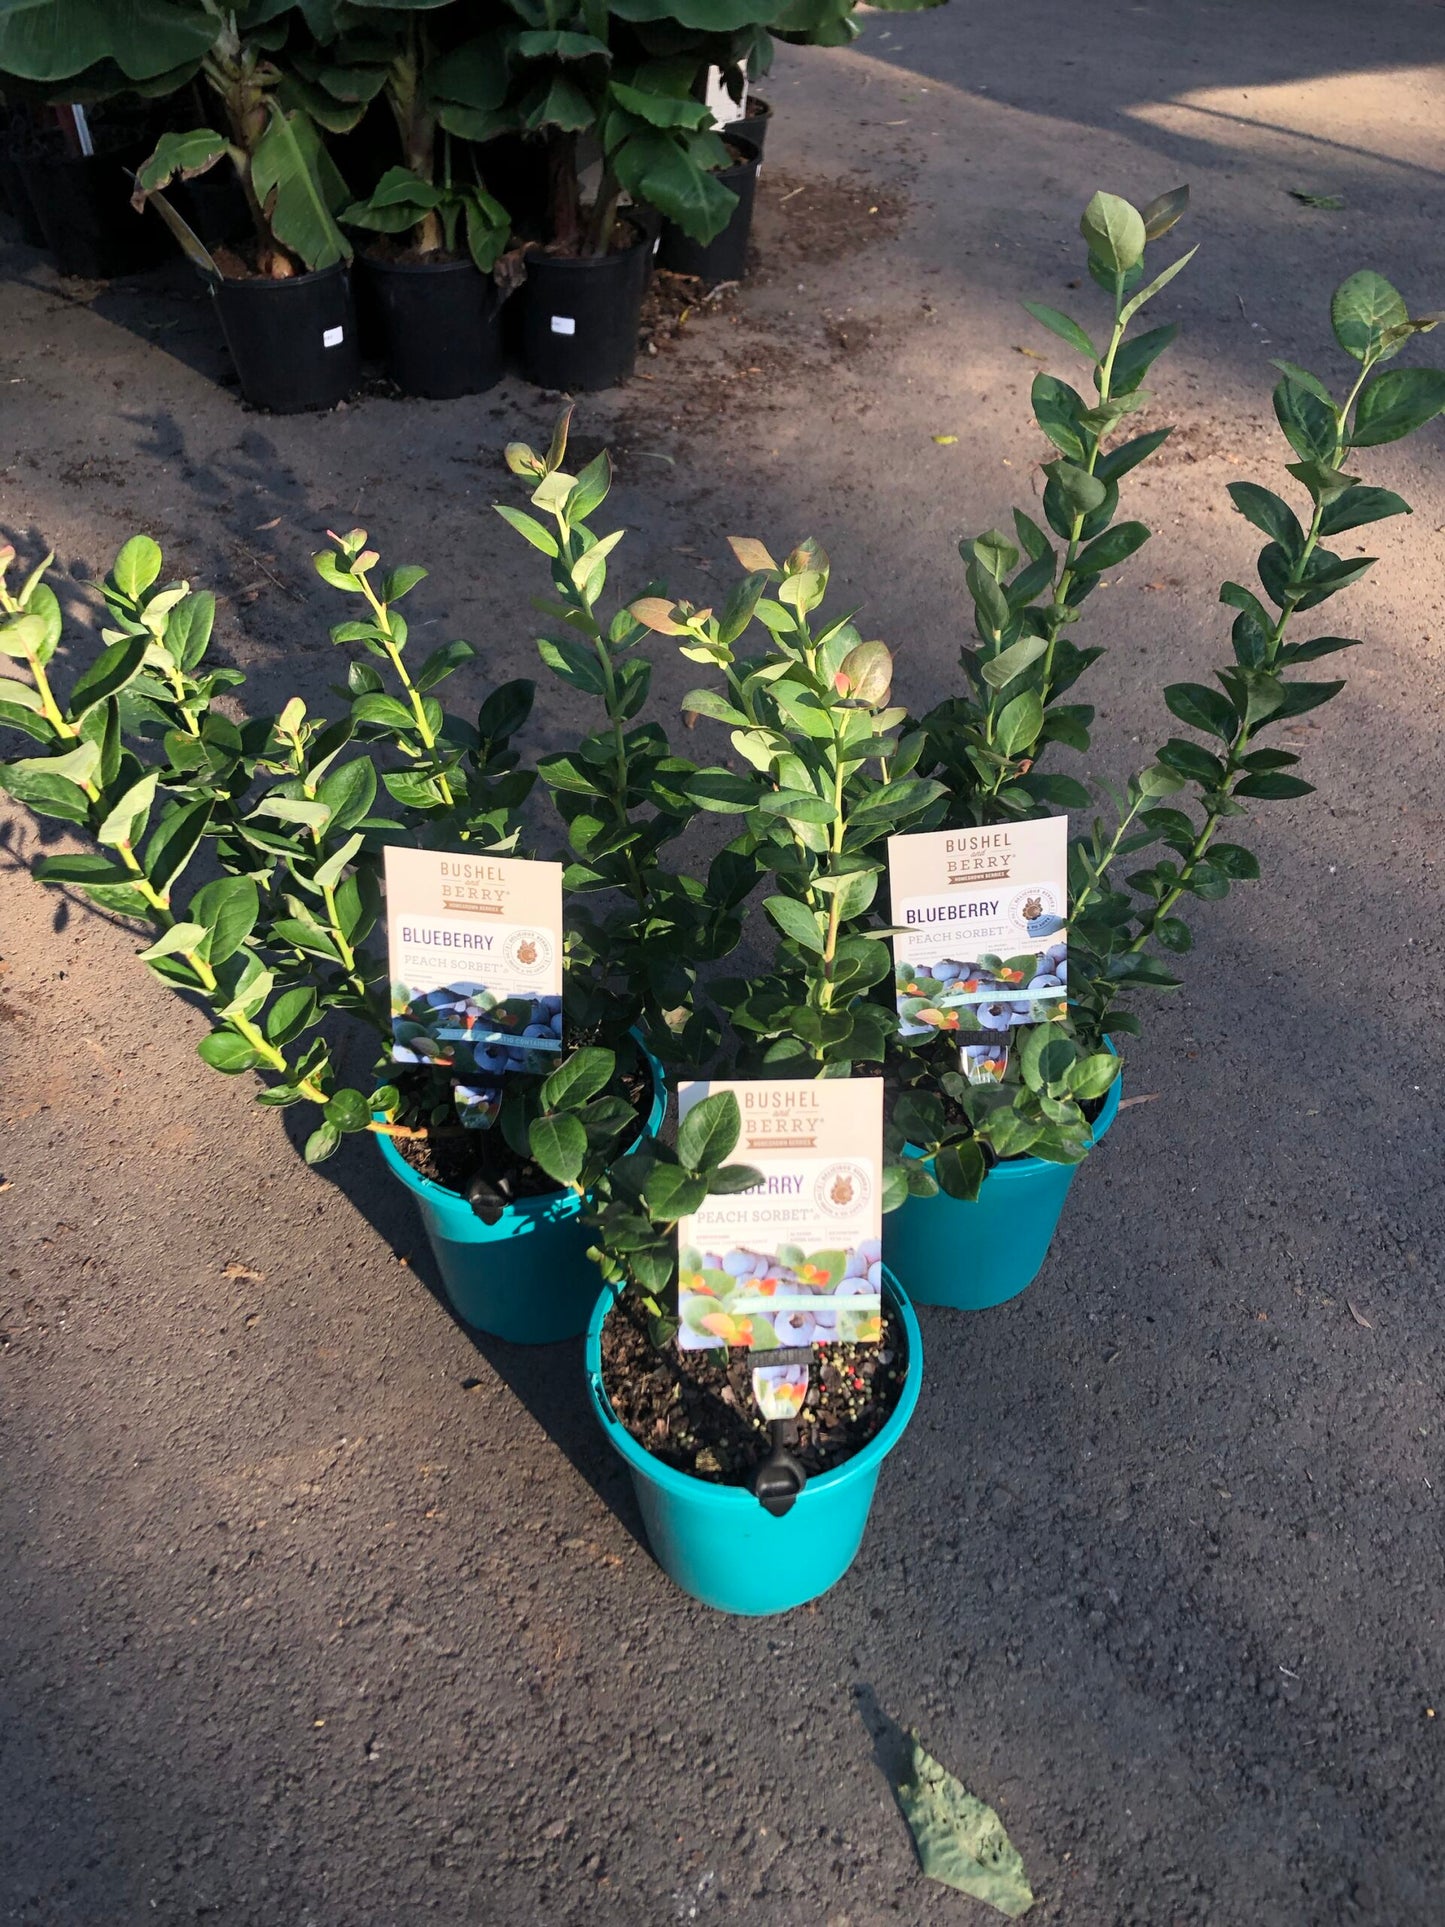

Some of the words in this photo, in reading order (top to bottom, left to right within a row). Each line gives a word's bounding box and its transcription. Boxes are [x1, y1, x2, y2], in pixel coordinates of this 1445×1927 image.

[946, 833, 1011, 853] BUSHEL
[970, 850, 986, 858] and
[441, 861, 505, 882] BUSHEL
[906, 900, 999, 924] BLUEBERRY
[403, 927, 494, 951] BLUEBERRY
[908, 932, 951, 945] PEACH
[404, 955, 447, 968] PEACH
[745, 1091, 819, 1109] BUSHEL
[697, 1210, 748, 1223] PEACH
